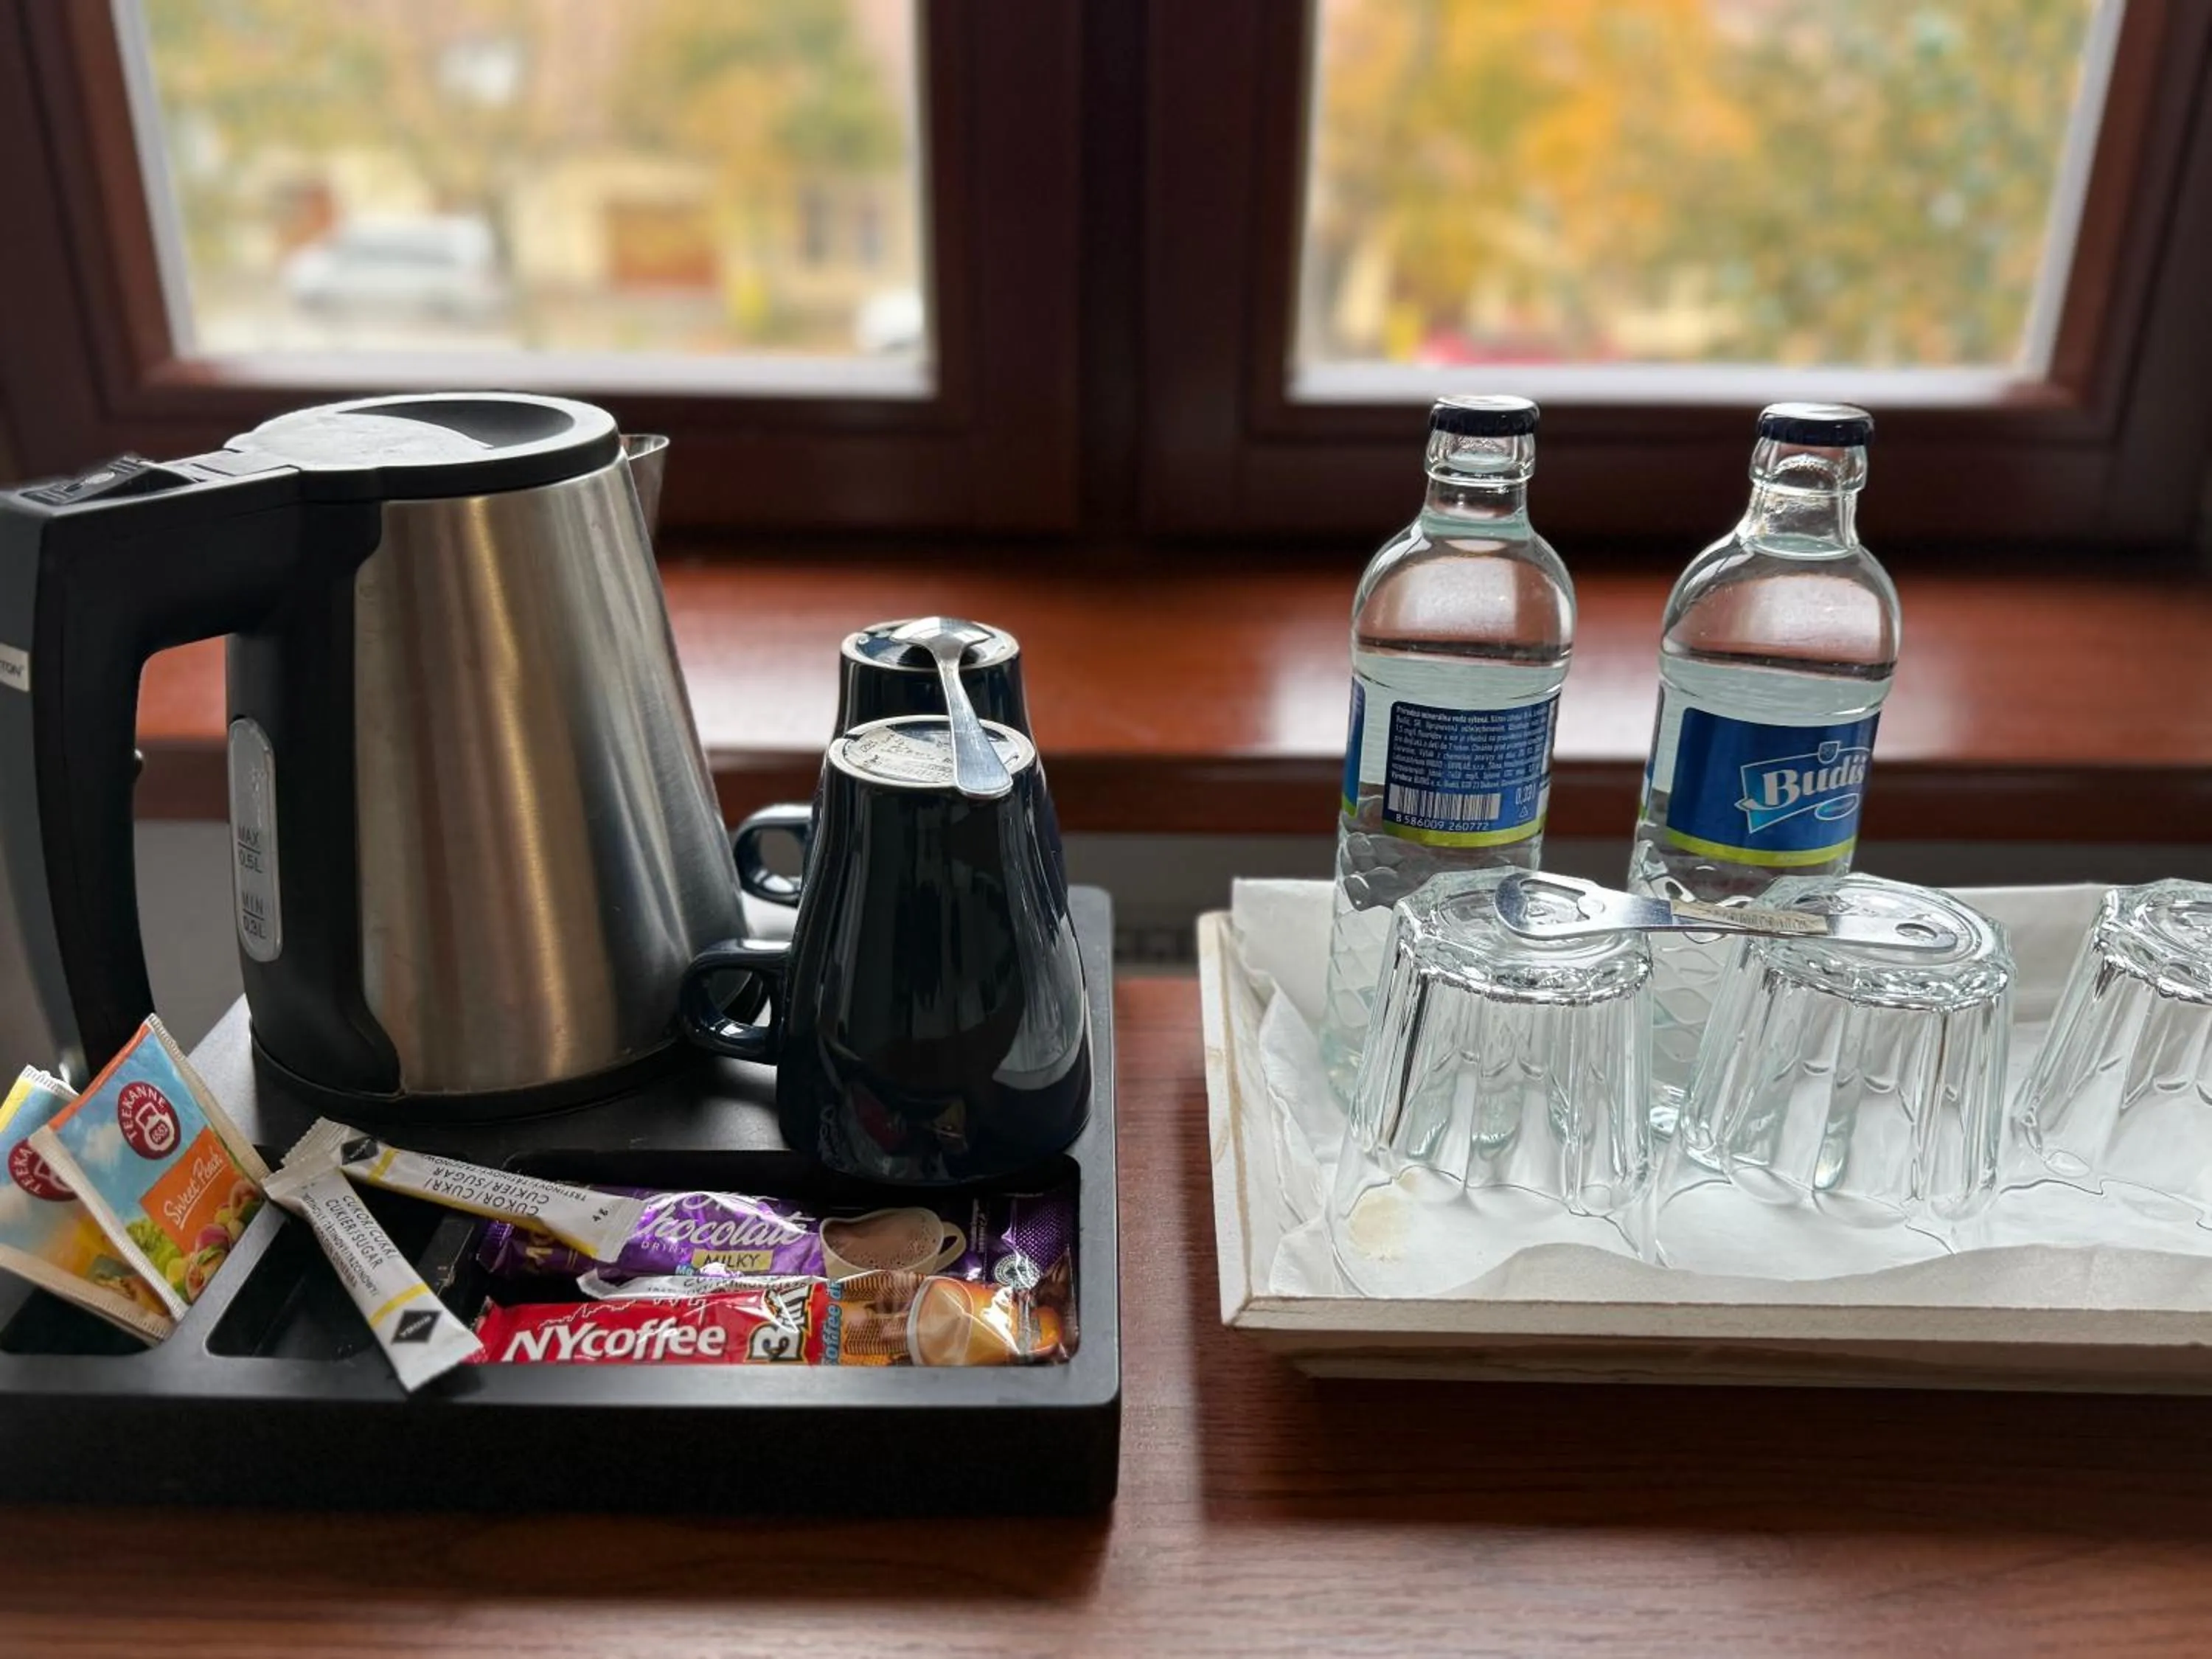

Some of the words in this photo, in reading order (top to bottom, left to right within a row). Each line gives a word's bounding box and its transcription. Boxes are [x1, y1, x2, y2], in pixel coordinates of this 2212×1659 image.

[121, 1085, 167, 1143] TEEKANNE
[14, 1148, 42, 1194] TEEKA
[433, 1166, 550, 1205] CUKIER/SUGAR
[164, 1182, 201, 1225] Sweet
[641, 1240, 688, 1256] DRINK
[704, 1253, 762, 1268] MILKY
[501, 1316, 727, 1362] NYcoffee
